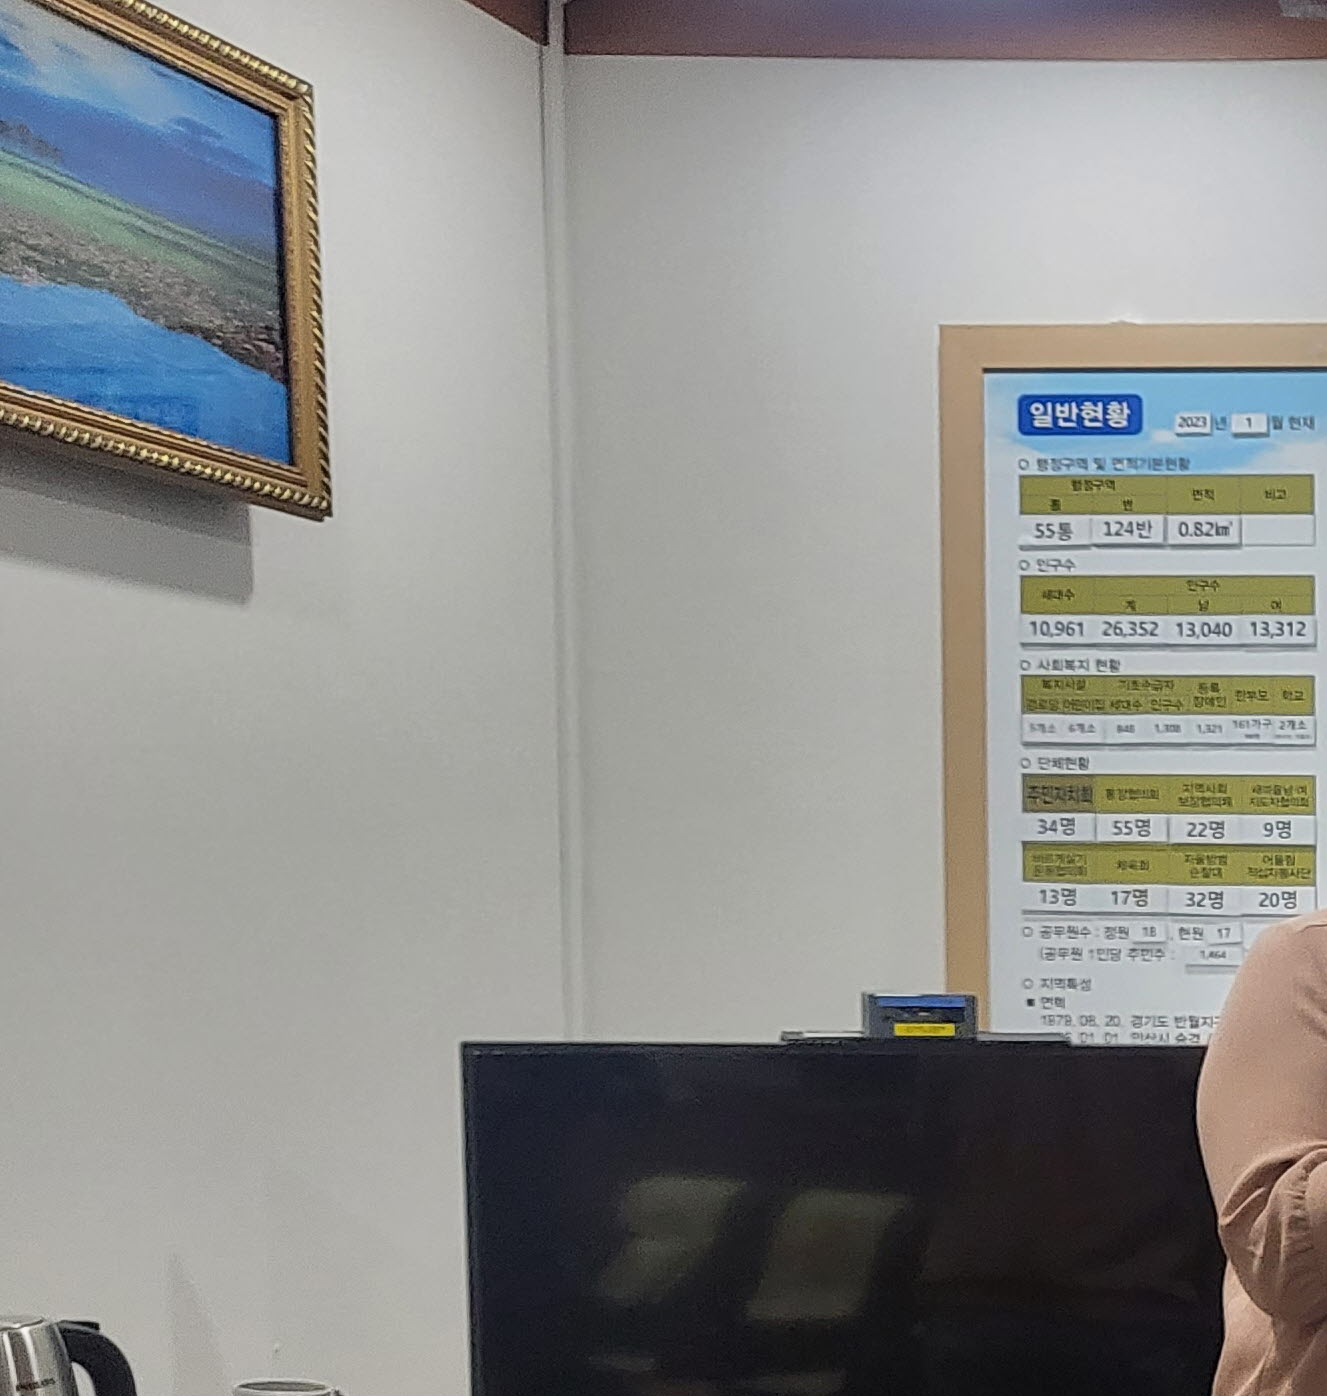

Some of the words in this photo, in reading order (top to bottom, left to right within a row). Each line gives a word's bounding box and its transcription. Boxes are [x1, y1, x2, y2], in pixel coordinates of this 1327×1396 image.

[1029, 401, 1131, 429] 일반현황
[1178, 415, 1207, 429] 2023
[1035, 521, 1073, 541] 55통
[1103, 520, 1153, 539] 124반
[1036, 558, 1076, 572] 인구수
[1029, 621, 1085, 640] 10,961
[1102, 621, 1160, 640] 26,352
[1176, 621, 1233, 640] 13,040
[1250, 621, 1307, 640] 13,312
[1037, 659, 1090, 672] 사회복지
[1095, 659, 1121, 672] 현황
[1037, 757, 1090, 771] 단체현황
[1037, 817, 1077, 838] 34명
[1113, 818, 1151, 838] 55명
[1186, 820, 1226, 840] 22명
[1263, 820, 1292, 841] 9명
[1039, 887, 1077, 908] 13명
[1111, 888, 1149, 908] 17명
[1185, 890, 1225, 910] 32명
[1258, 890, 1297, 910] 20명
[1217, 927, 1232, 939] 17
